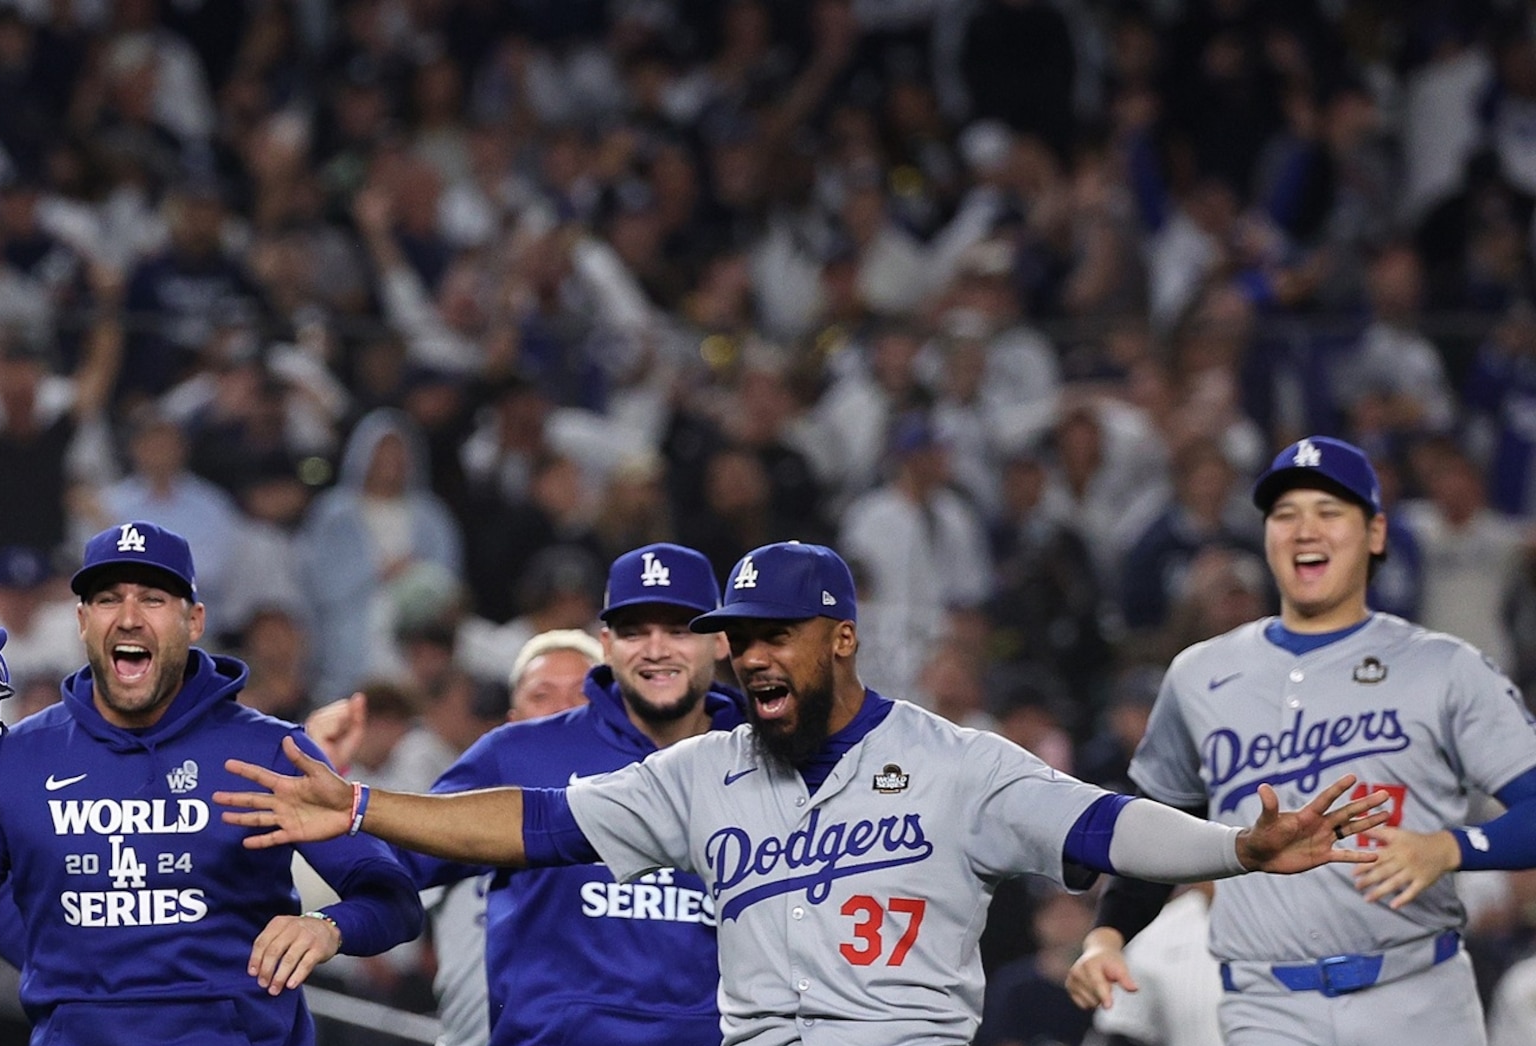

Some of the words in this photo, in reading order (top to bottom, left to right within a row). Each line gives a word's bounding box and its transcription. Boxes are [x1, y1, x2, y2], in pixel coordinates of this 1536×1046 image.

[116, 523, 146, 552] LA
[640, 552, 671, 587] LA
[733, 555, 759, 589] LA
[1202, 709, 1410, 803] Dodgers
[47, 798, 210, 835] WORLD
[65, 854, 99, 874] 20
[108, 835, 147, 888] LA
[157, 852, 193, 874] 24
[705, 808, 933, 908] Dodgers
[60, 888, 209, 927] SERIES
[580, 881, 718, 927] SERIES
[839, 894, 926, 967] 37
